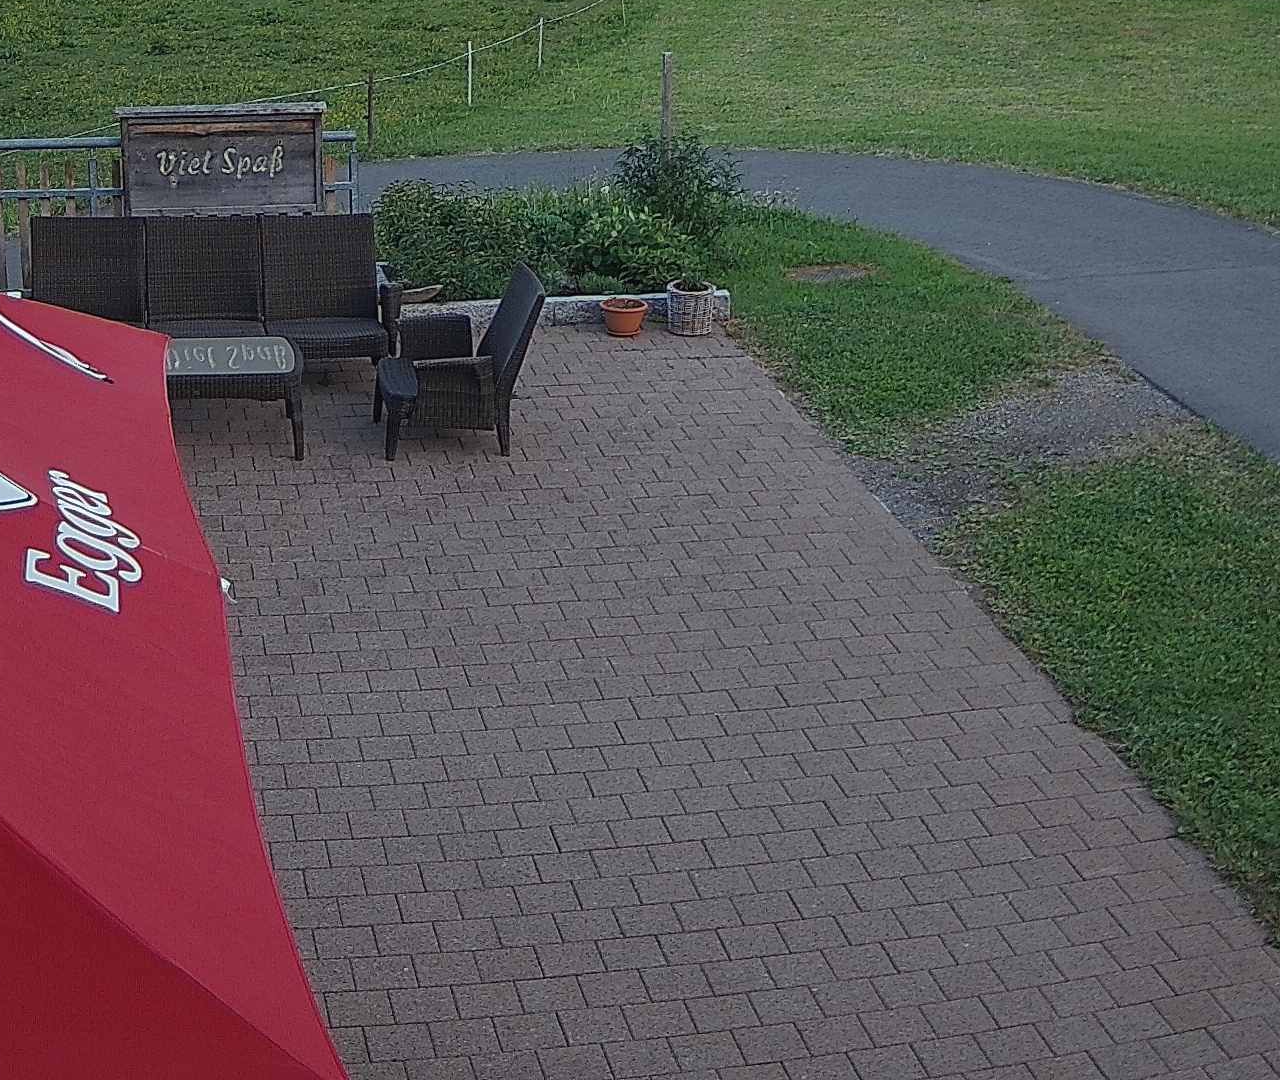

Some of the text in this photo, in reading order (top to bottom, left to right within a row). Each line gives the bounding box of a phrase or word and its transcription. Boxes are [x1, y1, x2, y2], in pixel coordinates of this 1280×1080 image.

[156, 145, 284, 179] Viel Spaß
[23, 469, 142, 613] Egger
